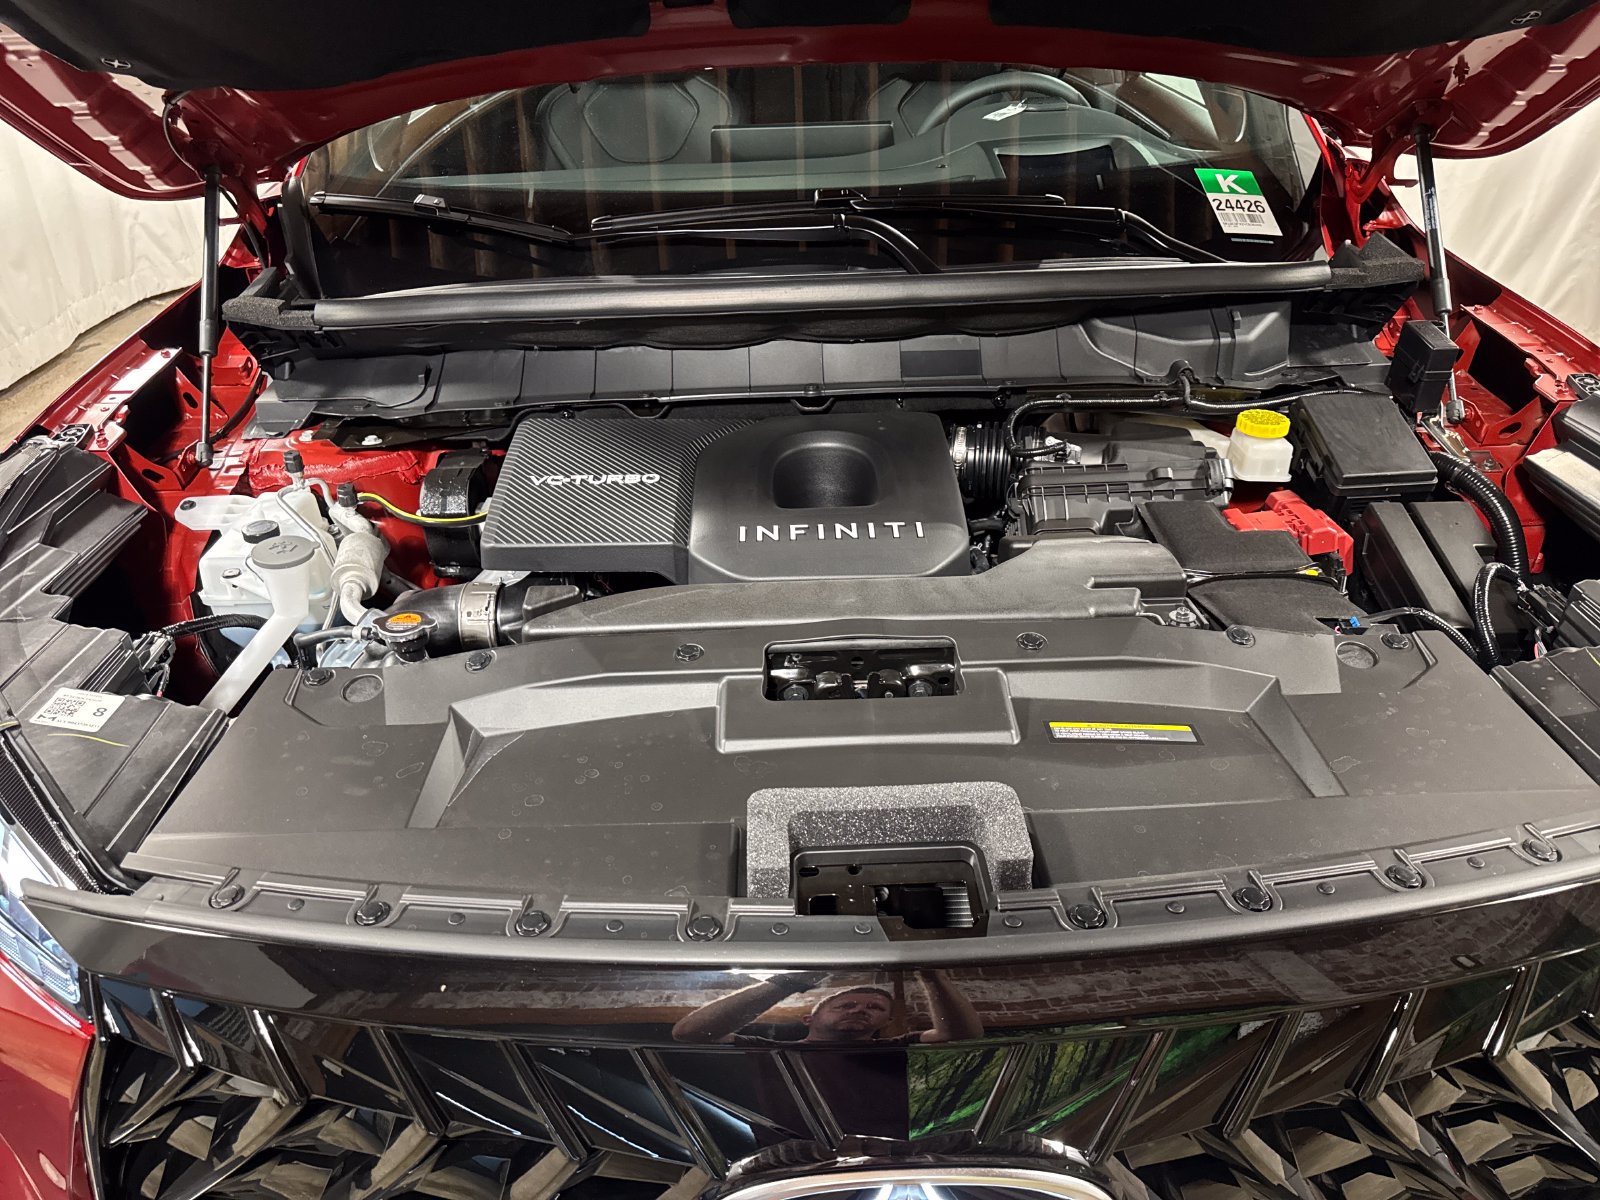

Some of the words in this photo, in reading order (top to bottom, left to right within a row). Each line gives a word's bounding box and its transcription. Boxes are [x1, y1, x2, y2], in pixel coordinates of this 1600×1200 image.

[1215, 173, 1248, 194] K
[1212, 198, 1266, 213] 24426
[528, 473, 661, 486] VC-TURBO
[738, 521, 925, 542] INFINITI
[92, 707, 108, 717] 8
